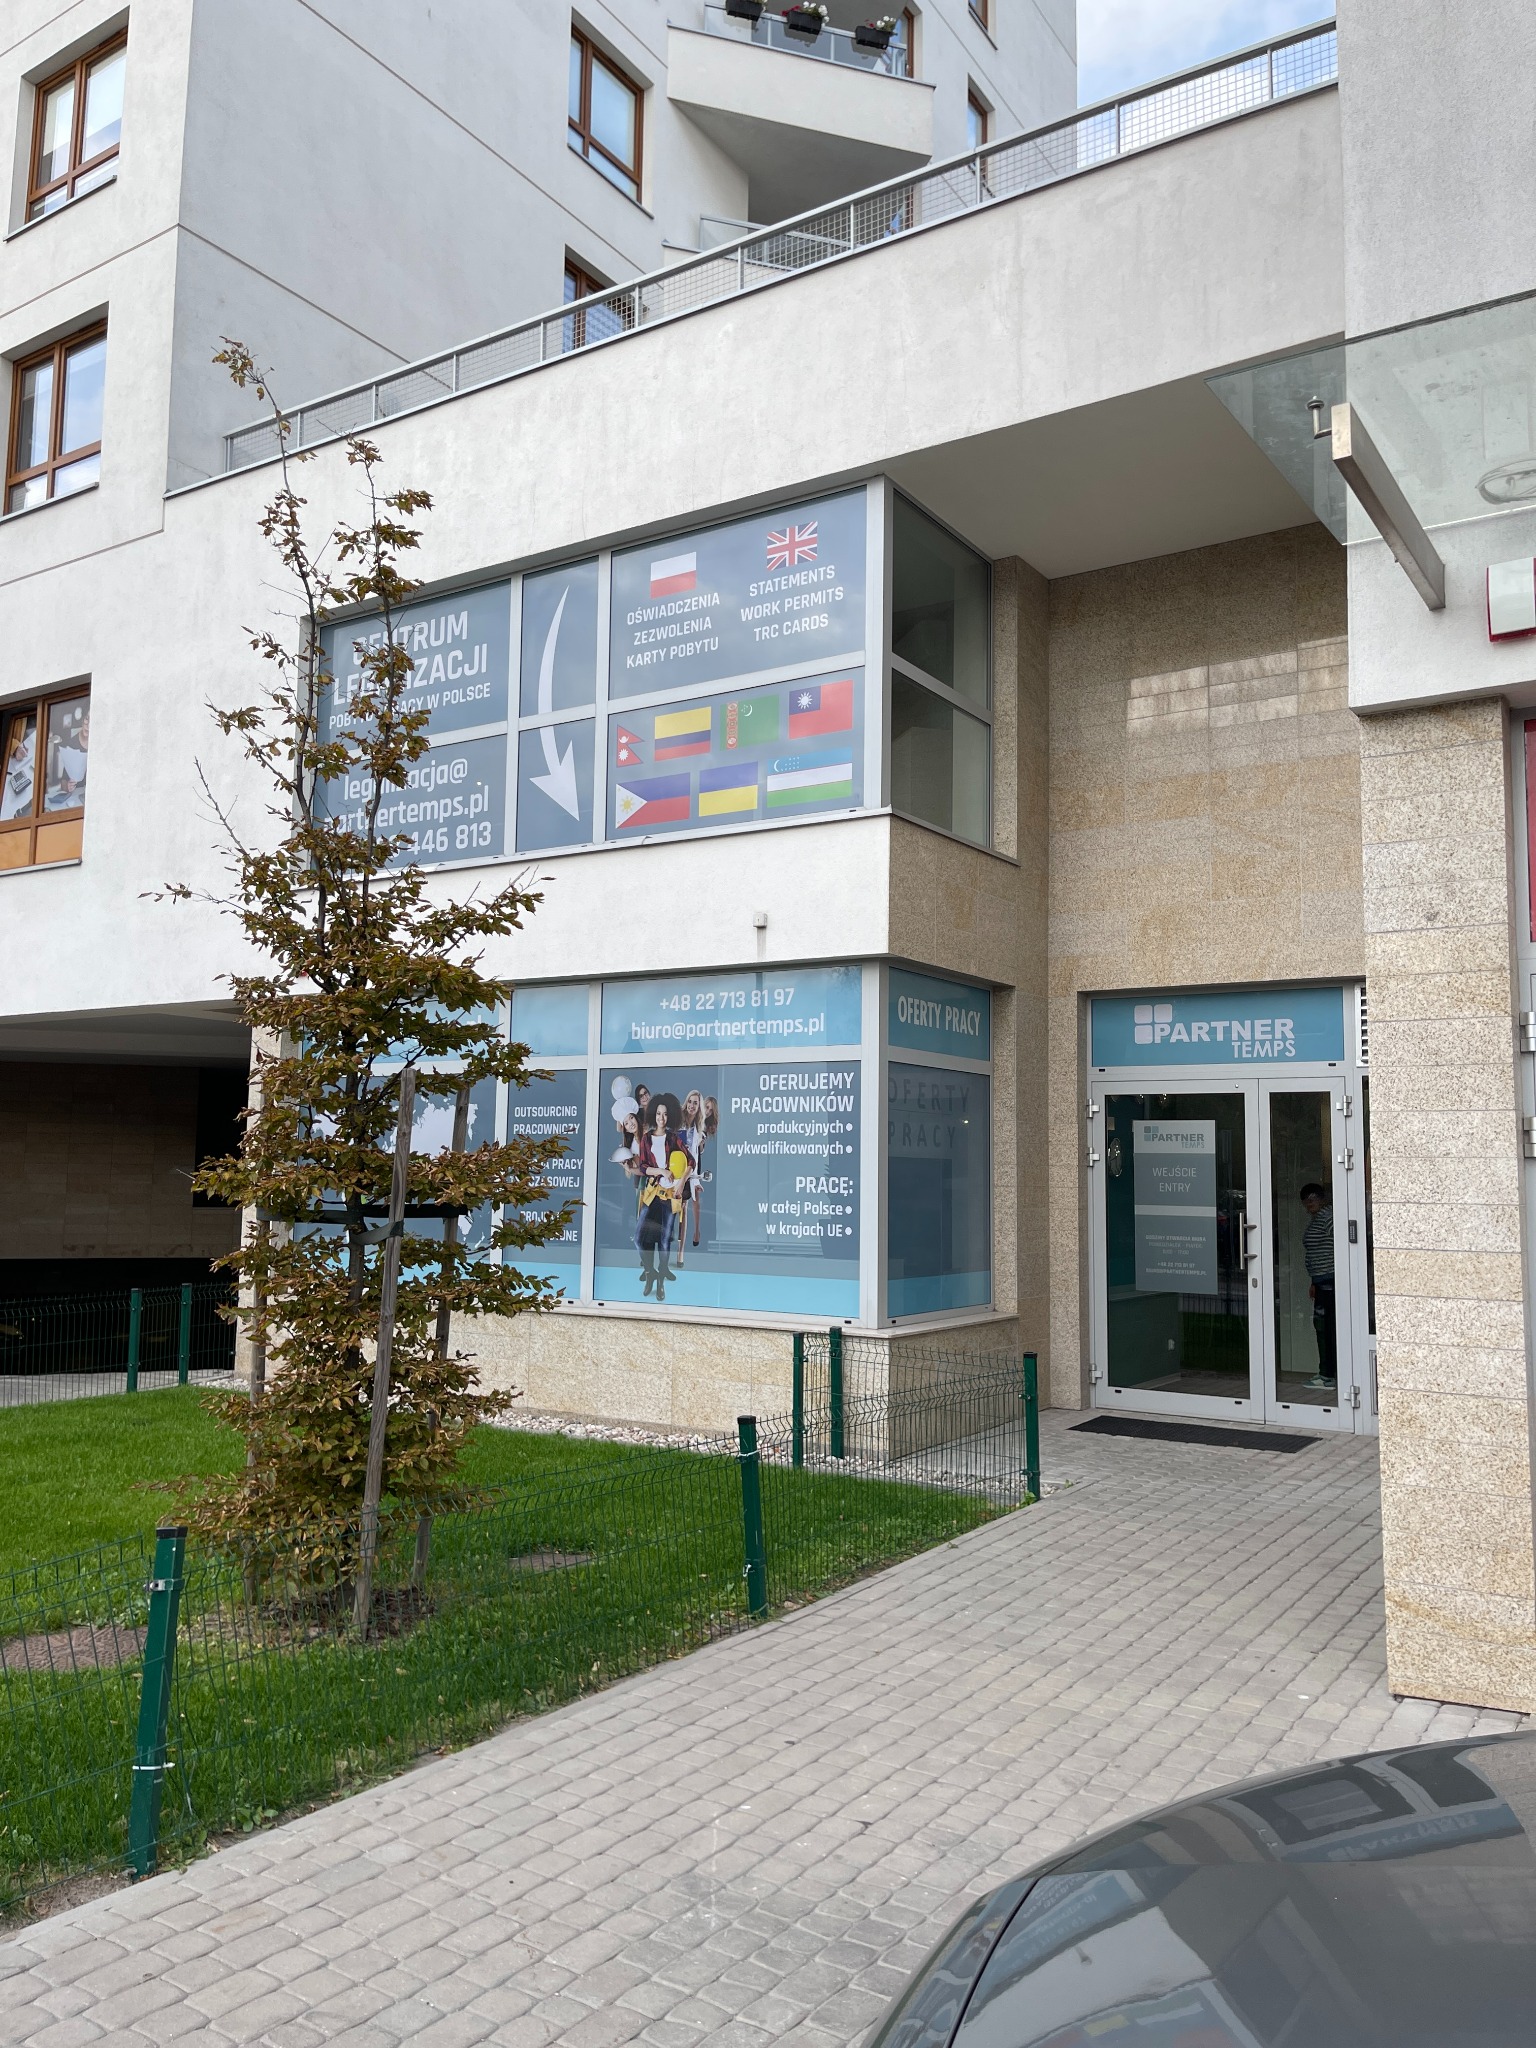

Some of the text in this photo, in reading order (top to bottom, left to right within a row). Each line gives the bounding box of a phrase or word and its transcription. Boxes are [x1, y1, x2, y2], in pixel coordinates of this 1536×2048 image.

[749, 565, 835, 597] STATEMENTS
[627, 592, 720, 626] OŚWIADCZENIA
[741, 586, 844, 622] WORK PERMITS
[634, 617, 711, 646] ZEZWOLENIA
[754, 613, 829, 642] TRC CARDS
[626, 637, 718, 669] KARTY POBYTU
[334, 644, 488, 705] LEGIZACJI
[427, 694, 439, 709] W
[443, 683, 491, 706] POLSCE
[407, 827, 448, 855] 446
[456, 821, 492, 849] 813
[660, 987, 795, 1012] +48 22 713 81 97
[631, 1012, 825, 1040] biuro@partnertemps.pl
[898, 995, 981, 1036] OFERTY PRACY
[1153, 1018, 1294, 1044] PARTNER
[1232, 1040, 1295, 1058] TEMPS
[759, 1072, 854, 1091] OFERUJEMY
[514, 1106, 577, 1117] OUTSOURCING
[731, 1091, 854, 1113] PRACOWNIKÓW
[513, 1123, 580, 1135] PRACOWNICZY
[757, 1120, 844, 1136] produkcyjnych
[1151, 1133, 1204, 1142] PARTNER
[727, 1141, 844, 1157] wykwalifikowanych
[552, 1159, 583, 1170] PRACY
[1152, 1165, 1197, 1177] WEJŚCIE
[795, 1176, 853, 1197] PRACĘ:
[1160, 1182, 1191, 1192] ENTRY
[758, 1200, 843, 1217] w całej Polsce
[766, 1221, 843, 1239] w krajach UE
